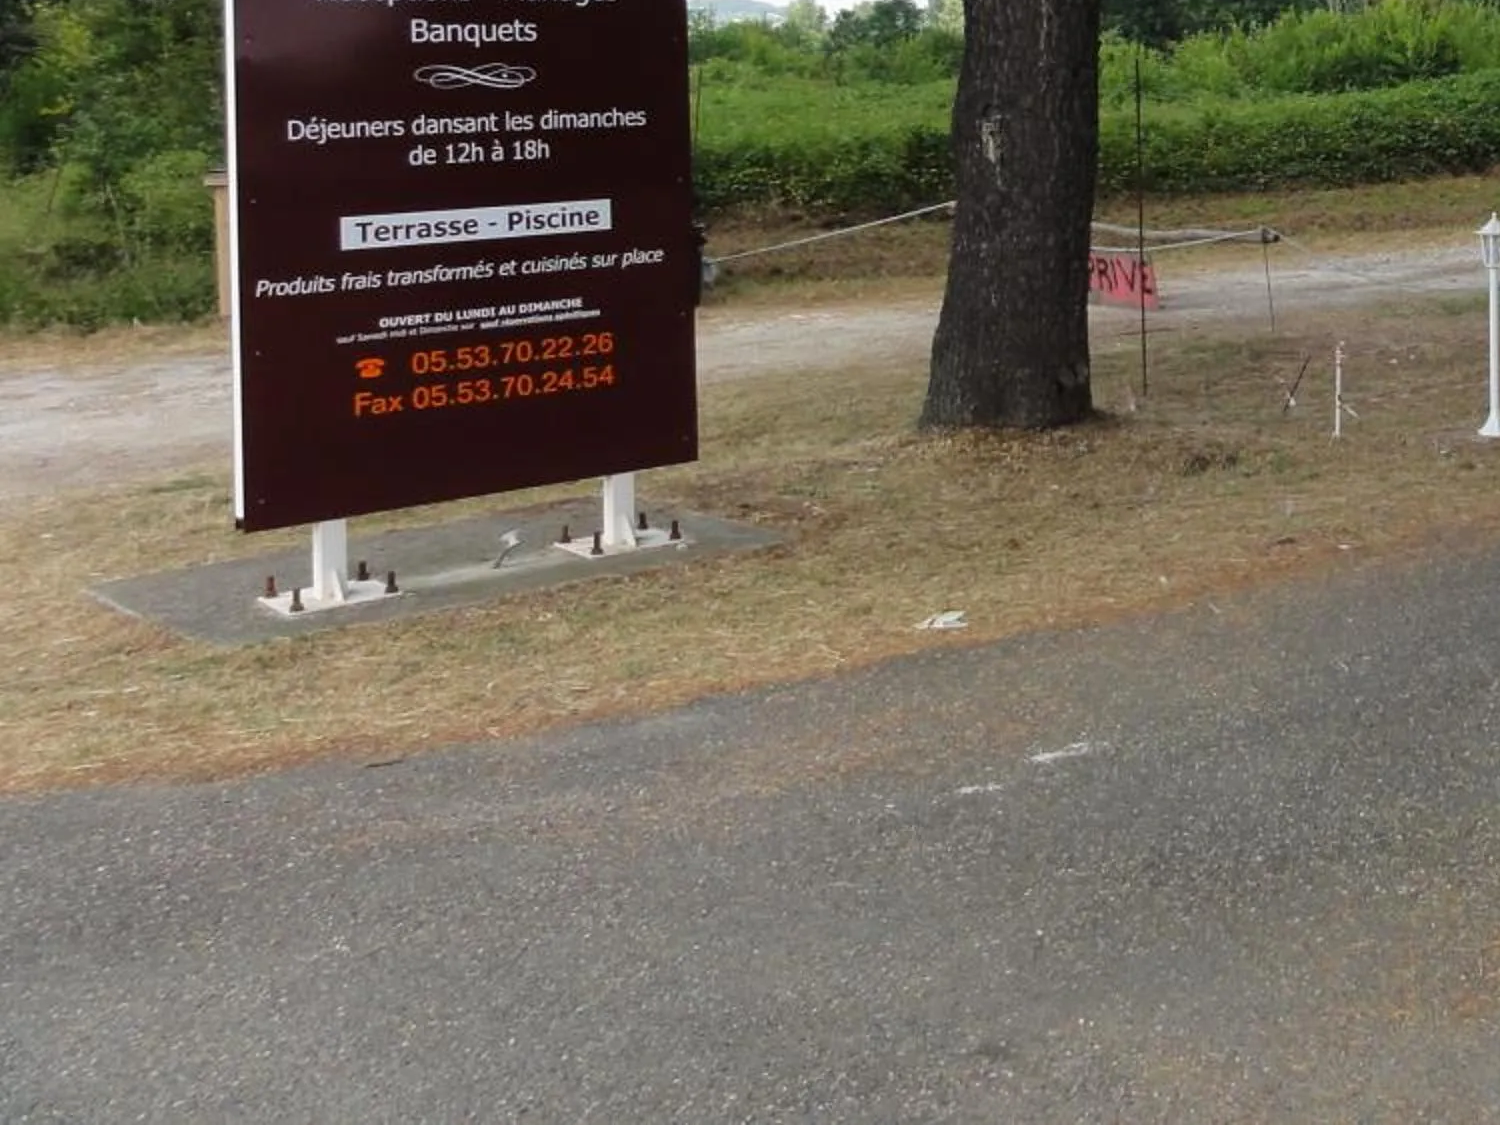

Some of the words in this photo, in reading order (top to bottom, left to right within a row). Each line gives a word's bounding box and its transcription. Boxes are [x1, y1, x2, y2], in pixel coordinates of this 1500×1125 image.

[411, 19, 537, 47] Banquets
[288, 117, 404, 144] Déjeuners
[412, 113, 499, 135] dansant
[506, 111, 534, 131] les
[540, 108, 646, 129] dimanches
[409, 145, 436, 165] de
[446, 142, 484, 163] 12h
[492, 139, 504, 161] à
[514, 139, 549, 159] 18h
[355, 221, 480, 243] Terrasse
[507, 208, 601, 232] Piscine
[256, 276, 335, 297] Produits
[341, 271, 382, 290] frais
[387, 260, 494, 286] transformés
[499, 260, 517, 275] et
[522, 252, 587, 274] cuisinés
[592, 254, 618, 267] sur
[622, 249, 664, 269] place
[379, 312, 431, 328] OUVERT
[434, 311, 452, 323] DU
[456, 307, 496, 321] LUNDI
[499, 304, 516, 316] AU
[519, 297, 584, 314] DIMANCHE
[411, 331, 614, 375] 05.53.70.22.26
[353, 391, 403, 416] Fax
[412, 364, 615, 410] 05.53.70.24.54
